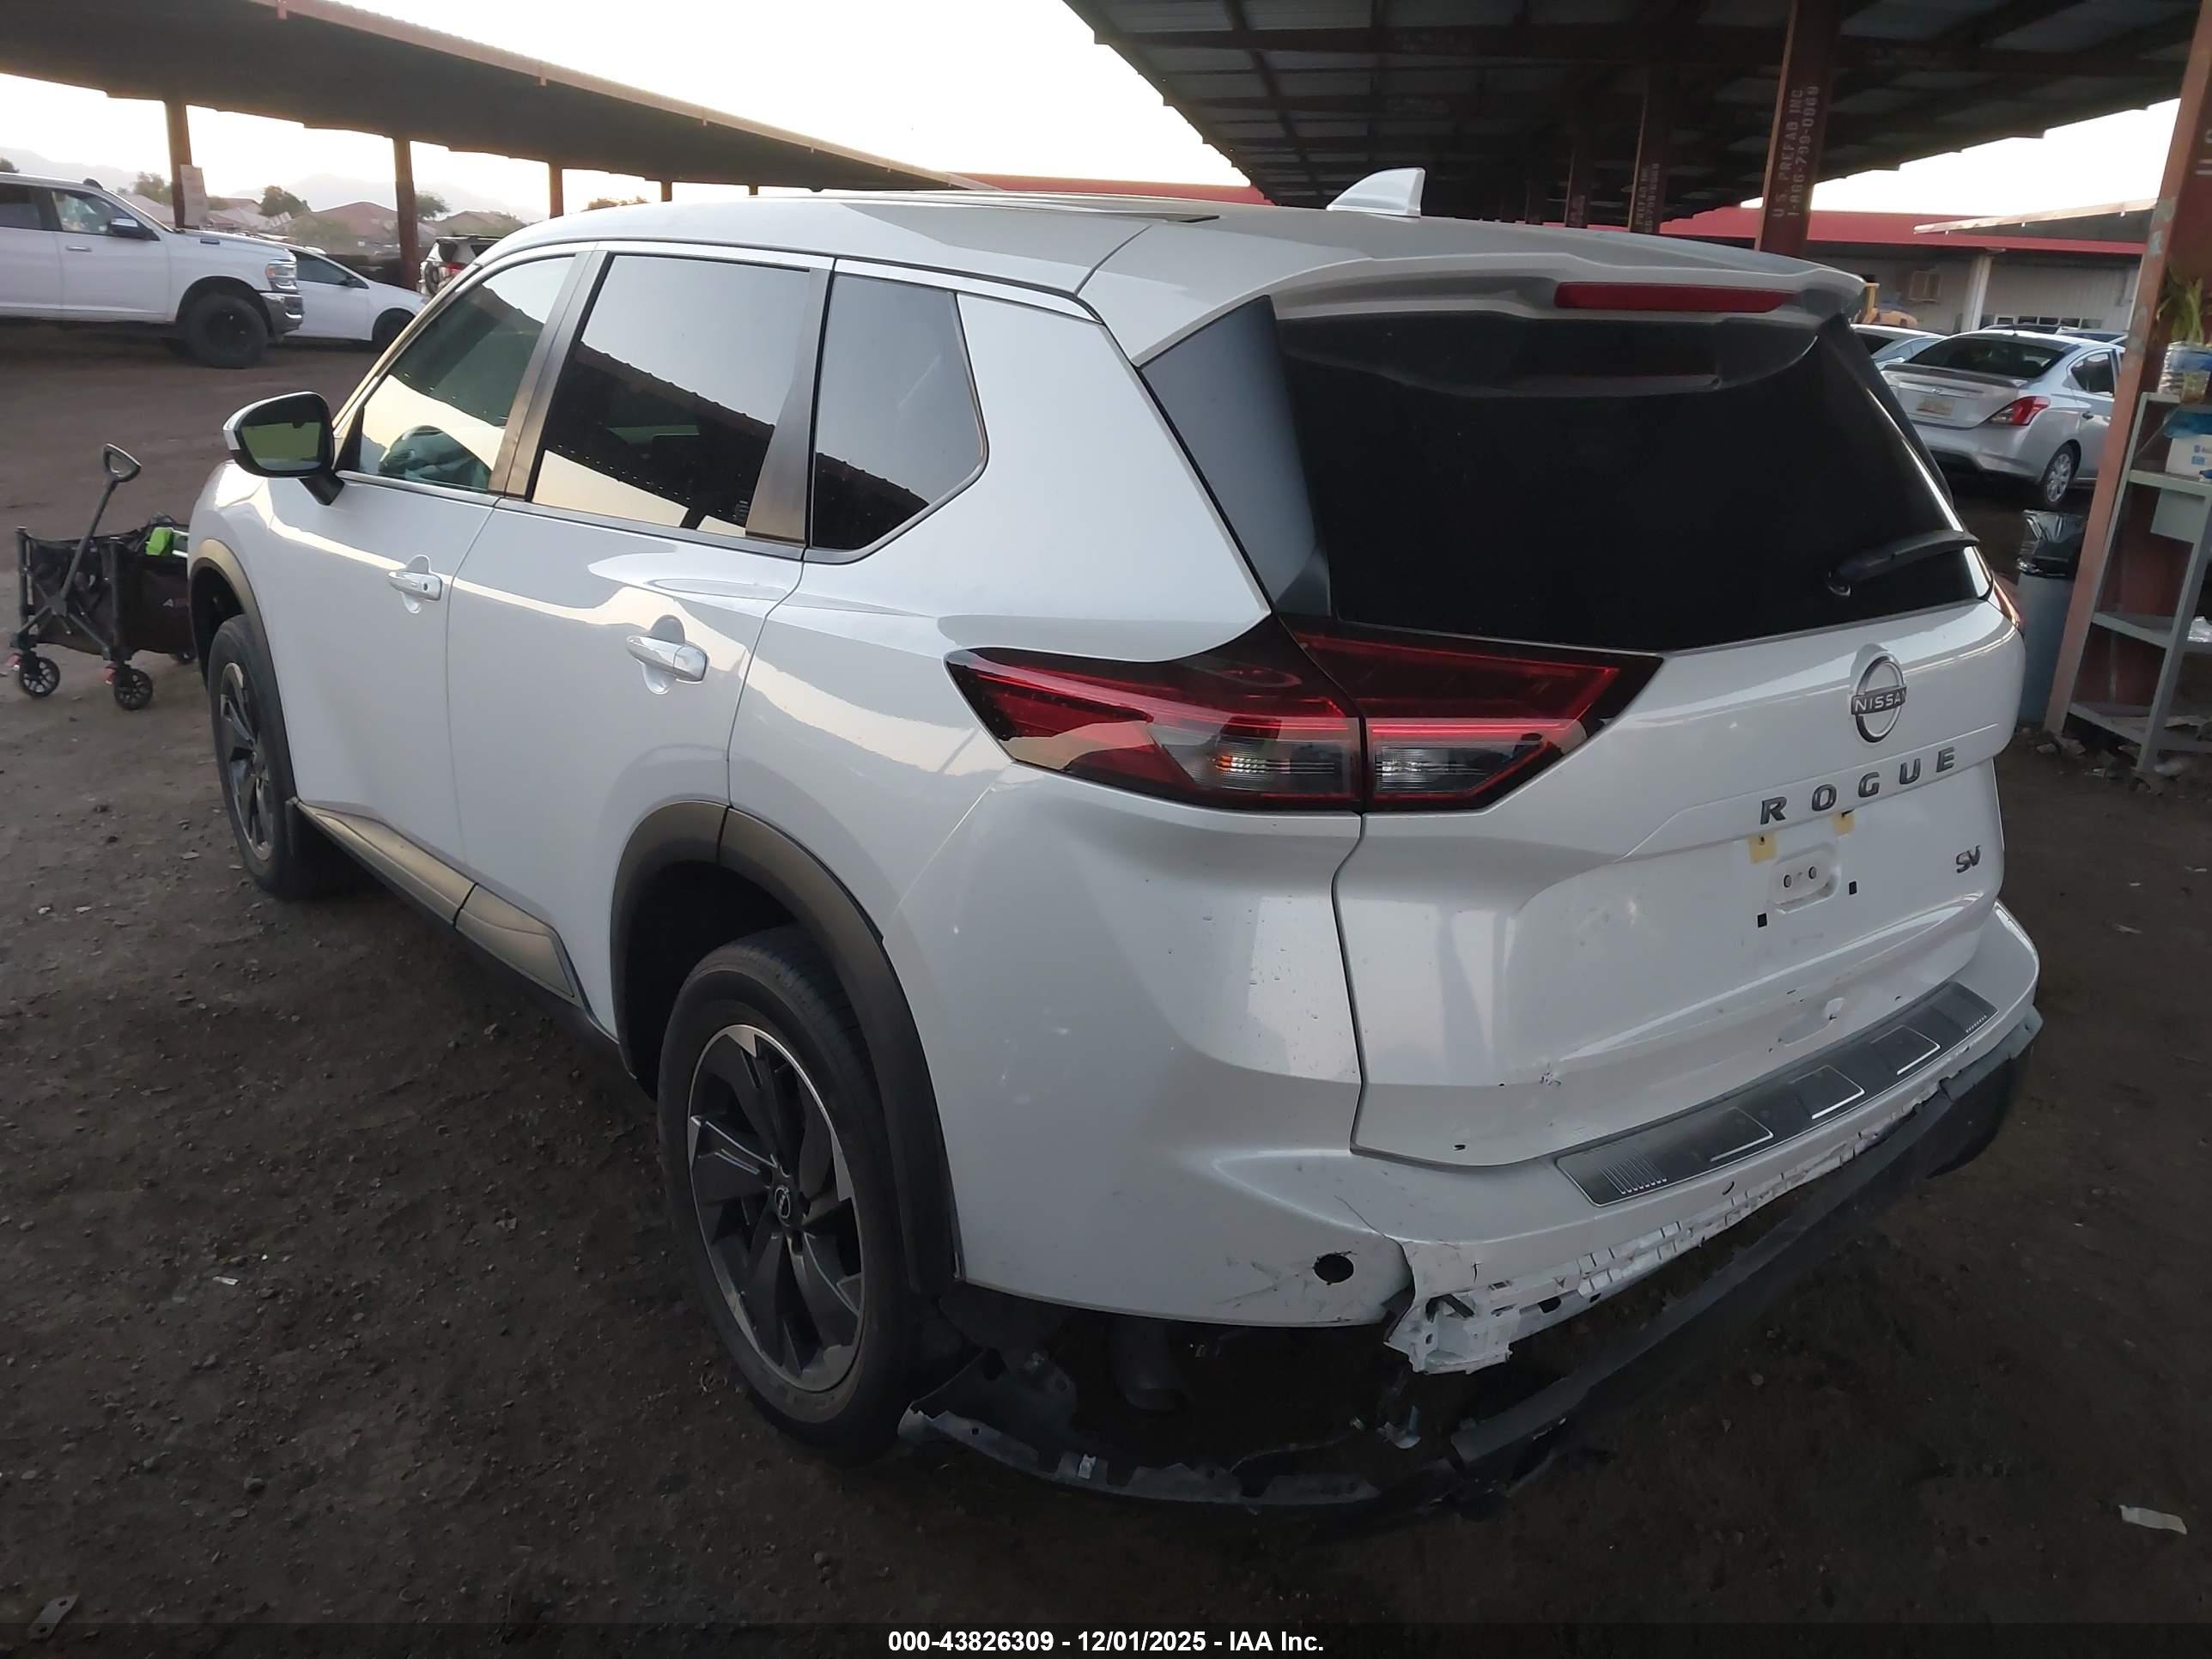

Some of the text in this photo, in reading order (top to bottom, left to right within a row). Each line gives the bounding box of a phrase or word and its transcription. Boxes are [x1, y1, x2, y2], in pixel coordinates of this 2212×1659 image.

[1778, 121, 1799, 180] PREFAB
[1854, 689, 1906, 713] NISSAN
[1759, 746, 1955, 825] ROGUE
[1955, 844, 1981, 873] SV
